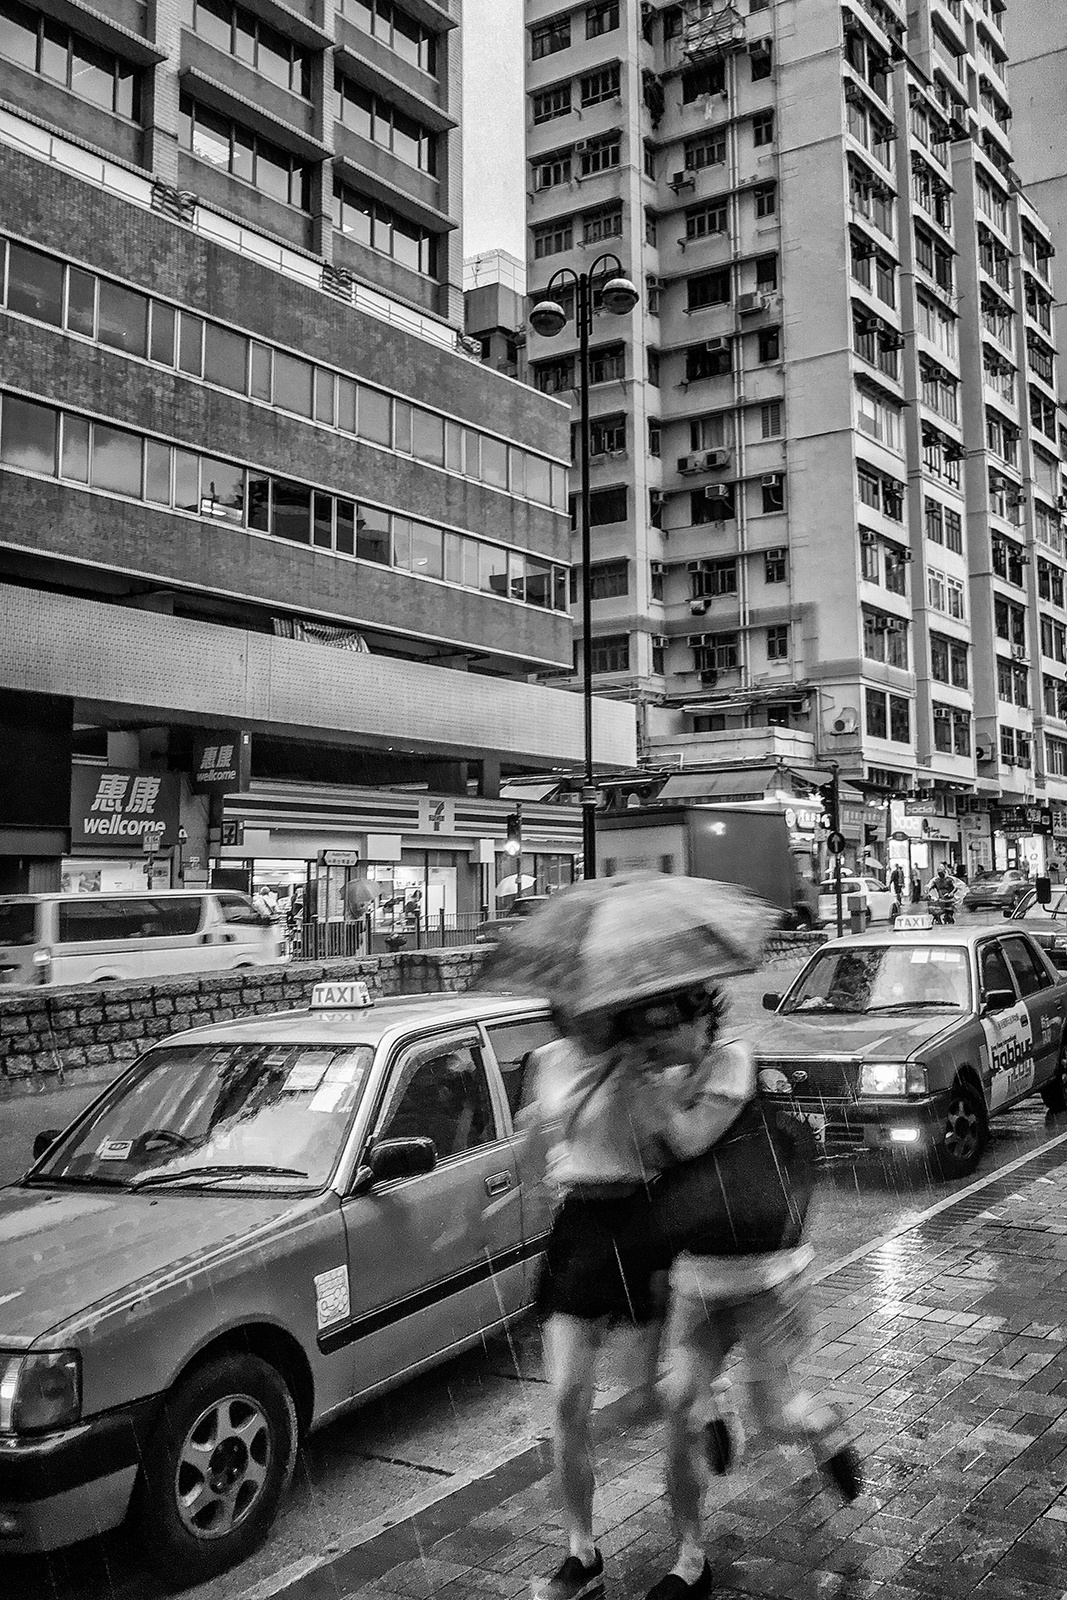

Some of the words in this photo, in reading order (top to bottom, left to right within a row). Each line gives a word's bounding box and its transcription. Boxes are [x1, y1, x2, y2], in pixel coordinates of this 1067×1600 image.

[200, 745, 234, 769] 惠康
[197, 769, 237, 782] wellcome
[90, 774, 161, 813] 惠康
[83, 814, 166, 837] wellcome
[896, 917, 925, 927] TAXI
[314, 987, 355, 1003] TAXI
